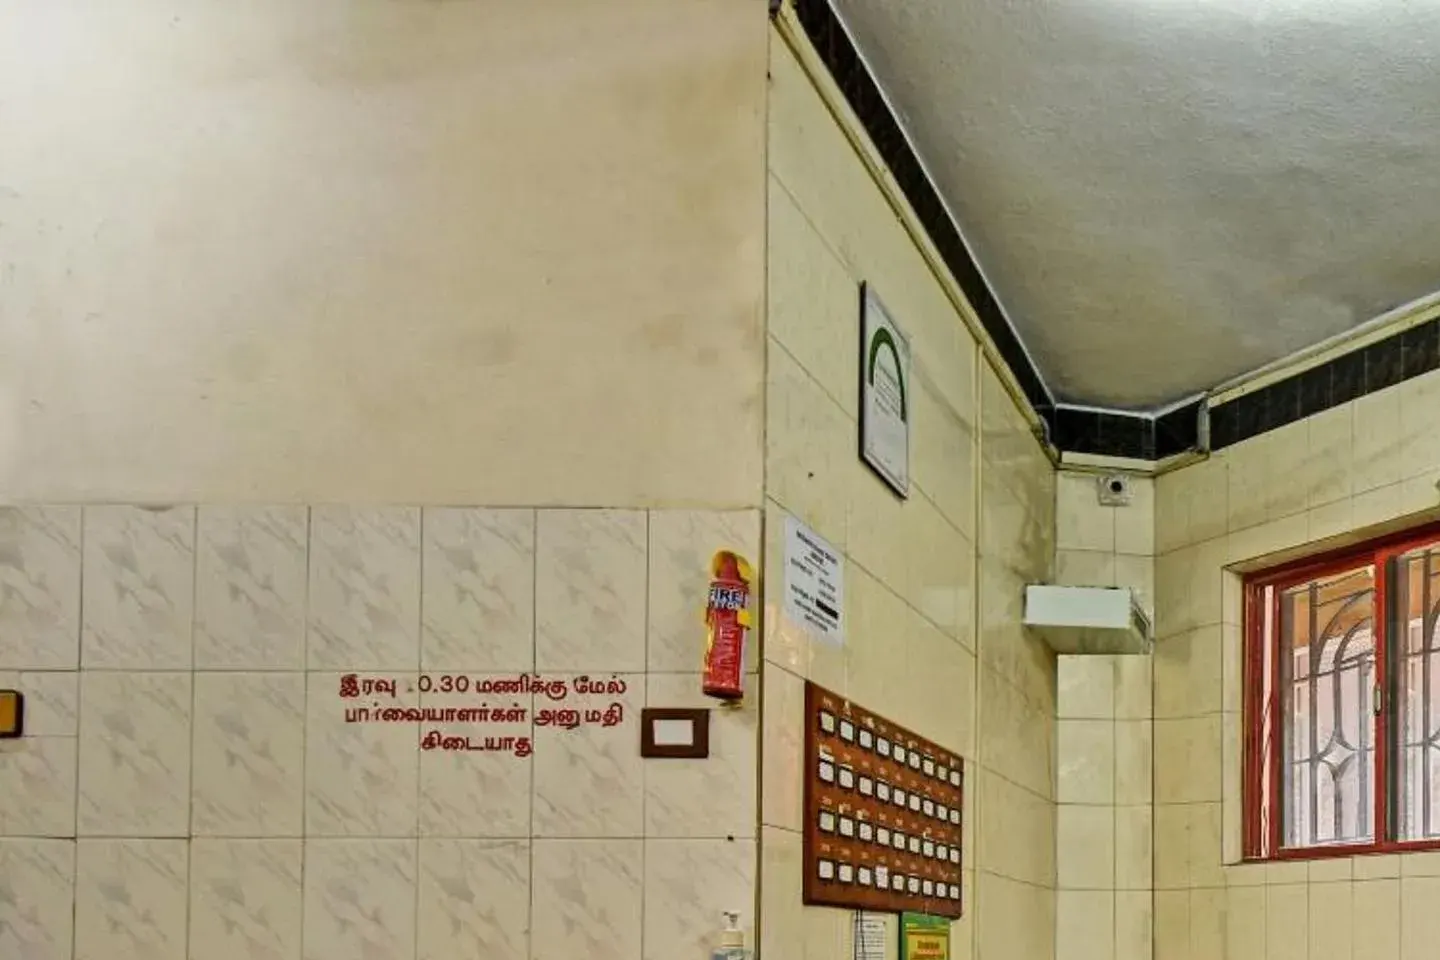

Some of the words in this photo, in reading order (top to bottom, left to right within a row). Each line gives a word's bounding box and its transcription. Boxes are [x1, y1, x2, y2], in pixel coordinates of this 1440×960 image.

[339, 674, 396, 698] இரவு
[407, 675, 469, 693] 0.30
[476, 673, 567, 700] மணிக்கு
[573, 675, 626, 694] மேல்
[421, 730, 533, 757] கிடையாது
